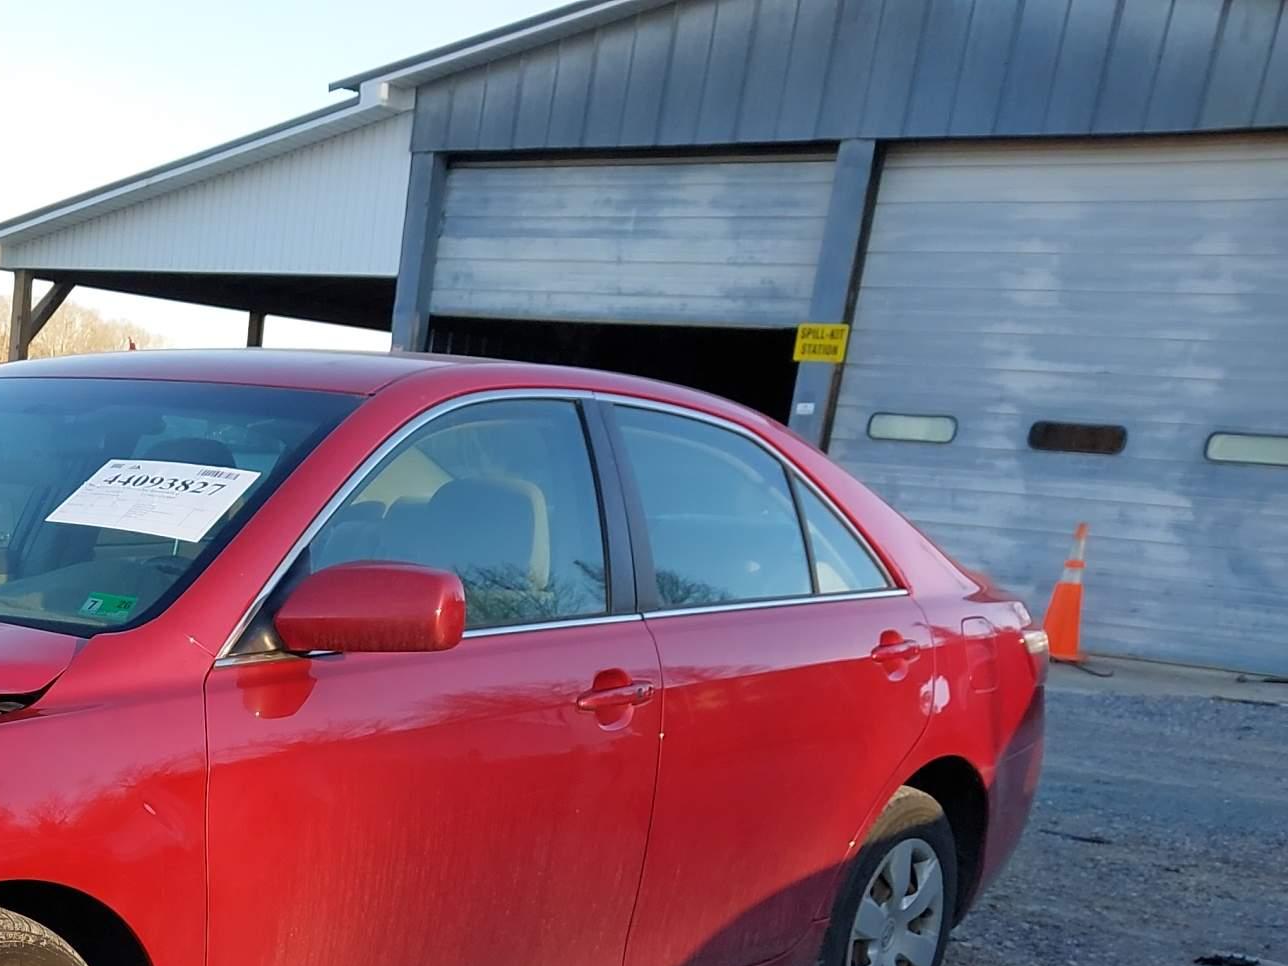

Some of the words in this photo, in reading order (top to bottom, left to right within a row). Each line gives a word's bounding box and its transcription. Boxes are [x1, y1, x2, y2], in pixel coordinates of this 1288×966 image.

[800, 343, 839, 356] STATION
[103, 473, 227, 496] 44093827
[87, 599, 100, 610] 7
